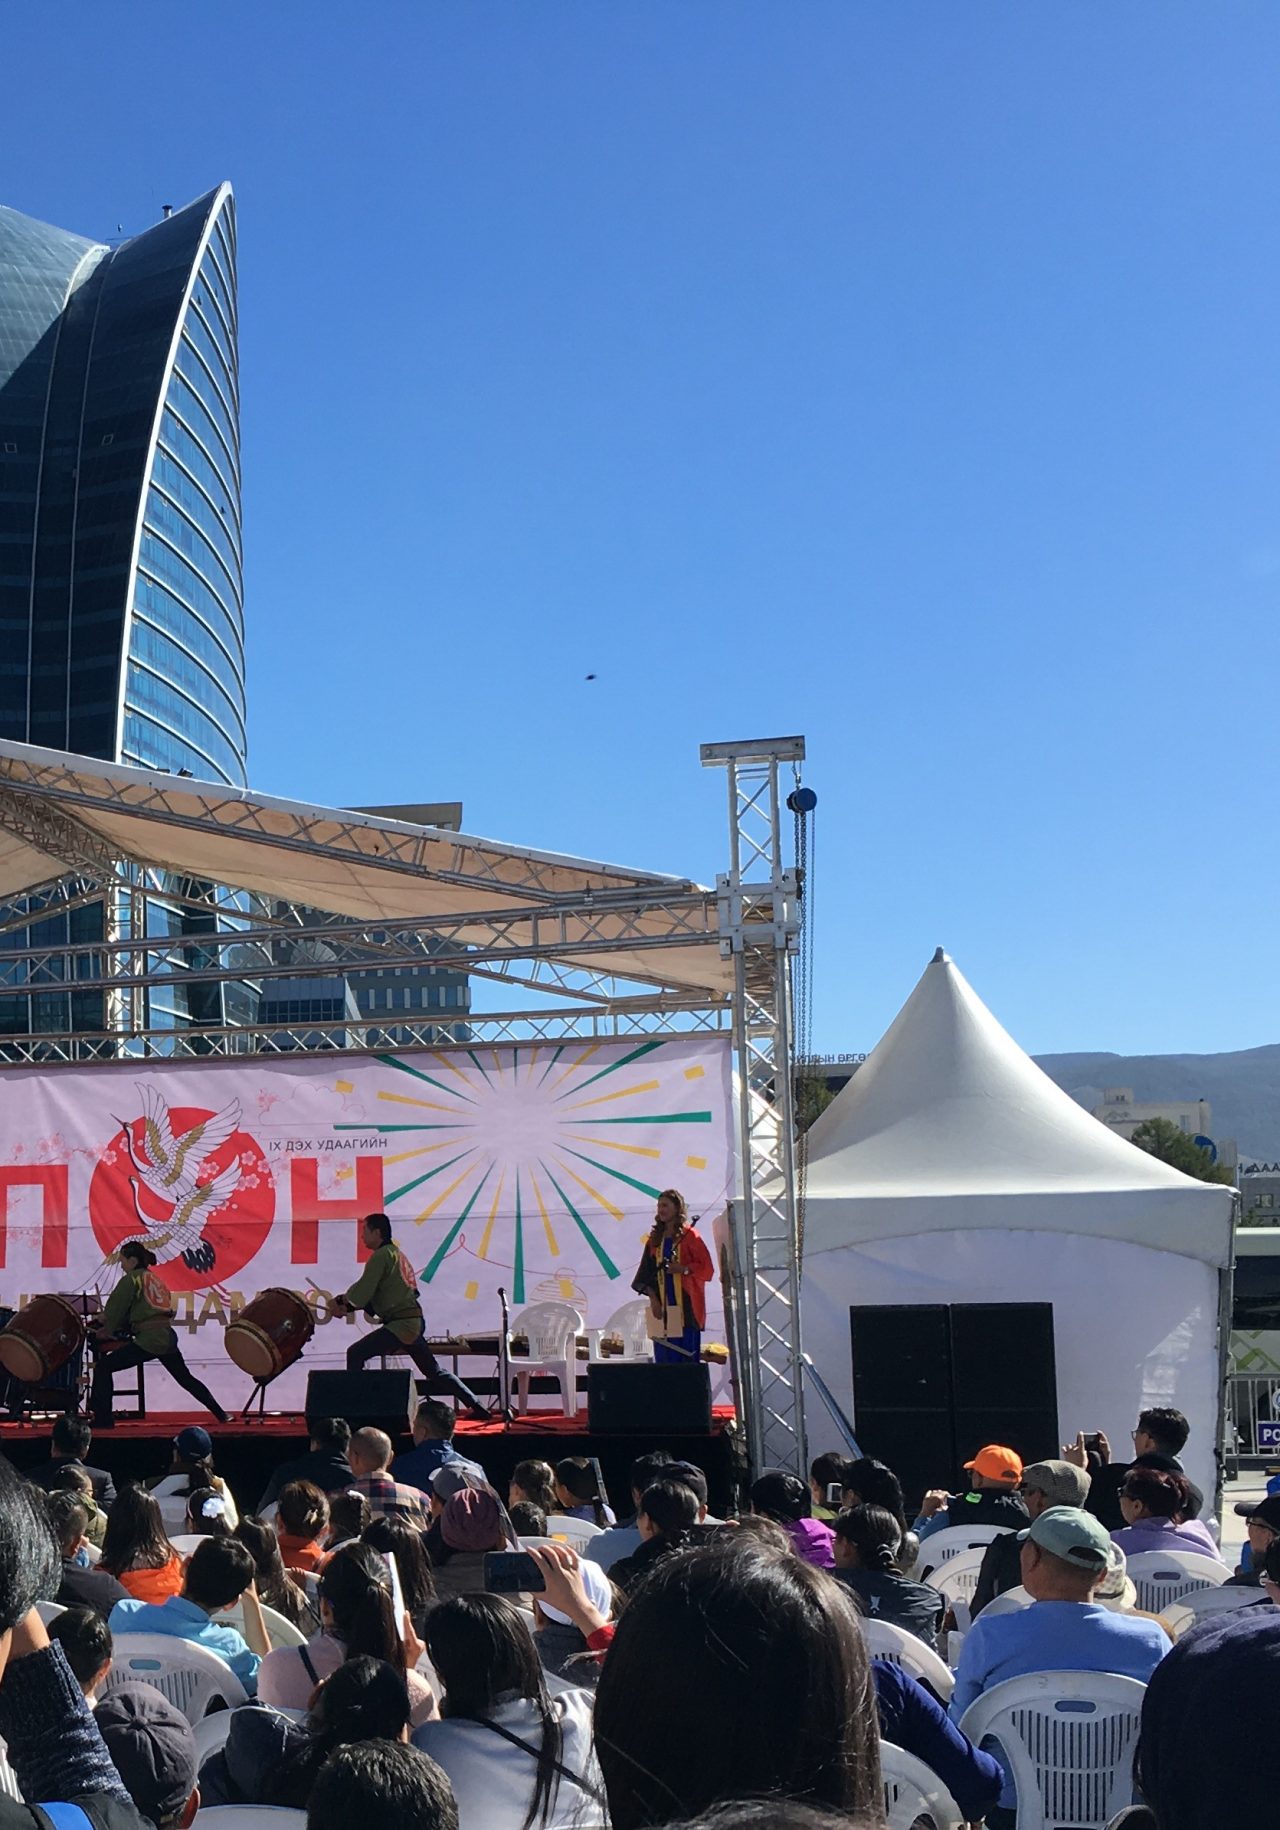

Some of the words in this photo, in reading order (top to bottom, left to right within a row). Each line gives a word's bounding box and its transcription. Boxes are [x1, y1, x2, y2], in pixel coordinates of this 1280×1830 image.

[838, 1053, 871, 1063] ӨРГӨ
[285, 1140, 312, 1152] ДЭХ
[317, 1137, 387, 1151] УДААГИЙН
